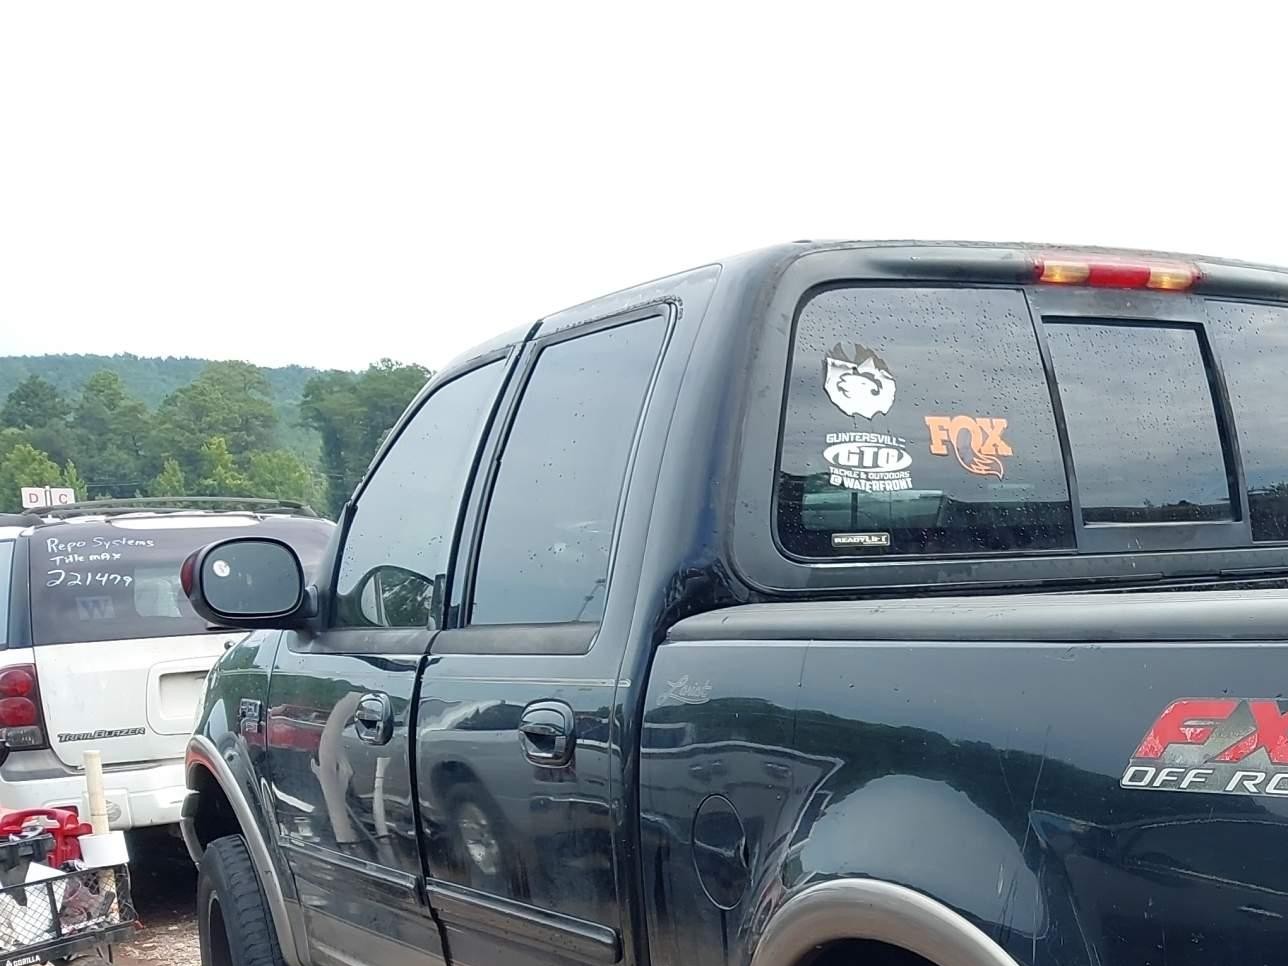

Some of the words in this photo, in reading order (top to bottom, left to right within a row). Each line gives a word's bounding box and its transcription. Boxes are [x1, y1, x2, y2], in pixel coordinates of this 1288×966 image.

[924, 415, 1013, 479] FOX
[838, 446, 899, 468] GTO
[28, 492, 39, 504] D
[58, 493, 68, 504] C
[46, 537, 86, 553] Repo
[93, 536, 155, 549] Systems
[46, 569, 133, 588] 221479
[1121, 766, 1214, 791] OFF
